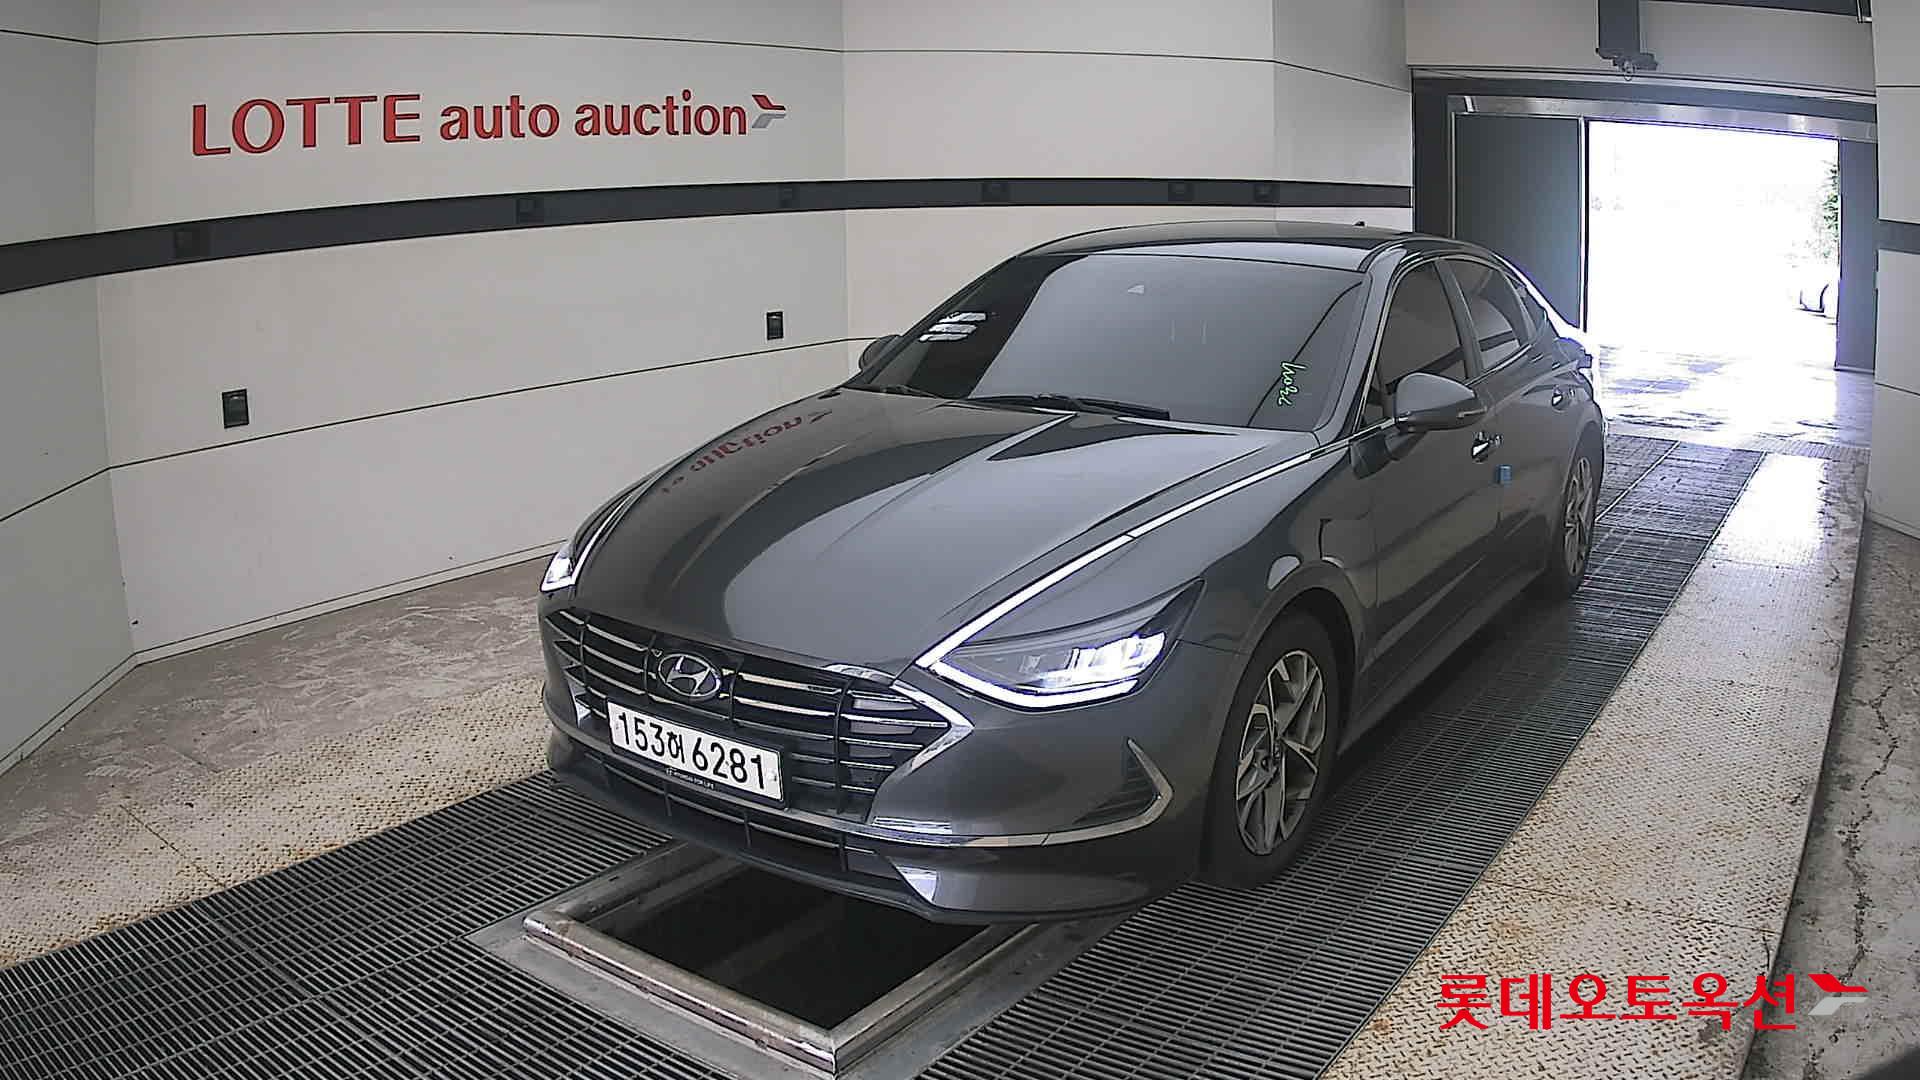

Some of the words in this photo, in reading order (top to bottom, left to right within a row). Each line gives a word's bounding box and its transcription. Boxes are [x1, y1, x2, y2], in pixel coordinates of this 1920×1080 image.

[192, 94, 421, 156] LOTTE
[440, 95, 560, 140] auto
[575, 89, 748, 136] auction
[618, 711, 685, 764] 153허
[692, 737, 765, 789] 6281
